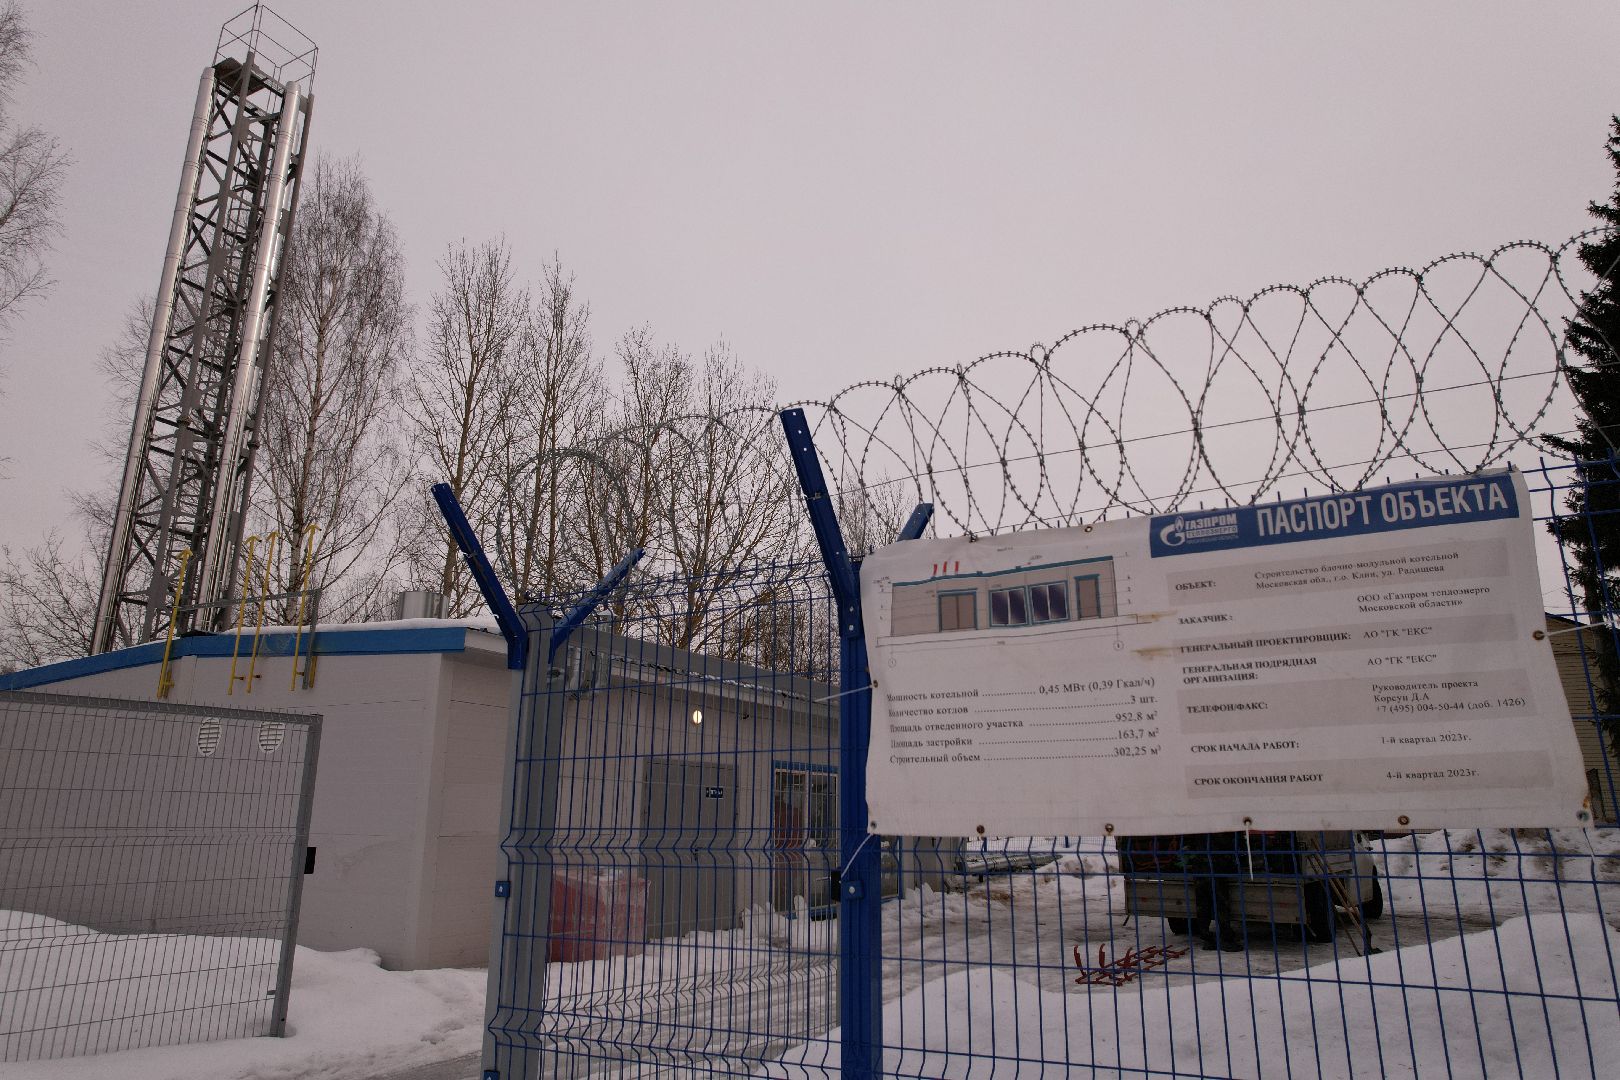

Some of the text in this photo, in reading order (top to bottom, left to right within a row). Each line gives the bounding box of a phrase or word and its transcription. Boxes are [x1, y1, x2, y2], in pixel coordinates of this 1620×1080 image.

[1257, 482, 1509, 537] ПАСПОРТ ОБЪЕКТА
[1185, 513, 1237, 530] ГАЗПРОМ
[1254, 567, 1318, 580] Строительство
[1409, 552, 1460, 563] котельной
[1175, 580, 1217, 592] ОБЪЕКТ:
[1256, 579, 1308, 590] Московская
[1398, 565, 1445, 575] Радищева
[1357, 586, 1490, 603] ООО «Газпром теплоэнерго
[1359, 602, 1416, 613] Московской
[1180, 632, 1352, 654] ГЕНЕРАЛЬНЫЙ ПРОЕКТИРОВЩИК:
[1363, 631, 1379, 639] АО
[1182, 657, 1318, 675] ГЕНЕРАЛЬНАЯ ПОДРЯДНАЯ
[1367, 658, 1382, 666] АО
[1183, 672, 1258, 685] ОРГАНИЗАЦИЯ:
[930, 689, 979, 700] котельной
[1039, 684, 1061, 696] 0,45
[1063, 682, 1086, 693] МВт
[1088, 680, 1114, 692] (0,39
[1117, 677, 1156, 689] Гкал/ч)
[1372, 681, 1479, 694] Руководитель проекта
[936, 706, 969, 715] котлов
[1139, 695, 1158, 704] шт.
[1374, 694, 1409, 704] Корсун
[1390, 704, 1414, 714] (495)
[1417, 702, 1464, 712] 004-50-44
[1497, 697, 1526, 708] 1426)
[1186, 702, 1268, 714] ТЕЛЕФОН/ФАКС:
[925, 721, 984, 732] отведенного
[986, 719, 1024, 731] участка
[1115, 712, 1143, 723] 952,8
[926, 738, 973, 748] застройки
[1118, 729, 1144, 740] 163,7
[1190, 740, 1300, 754] СРОК НАЧАЛА РАБОТ:
[1381, 732, 1472, 746] 1-й квартал 2023г.
[951, 752, 981, 763] объем
[1114, 746, 1147, 757] 302,25
[1194, 774, 1324, 786] СРОК ОКОНЧАНИЯ РАБОТ
[1386, 768, 1480, 781] 4-й квартал 2023г.
